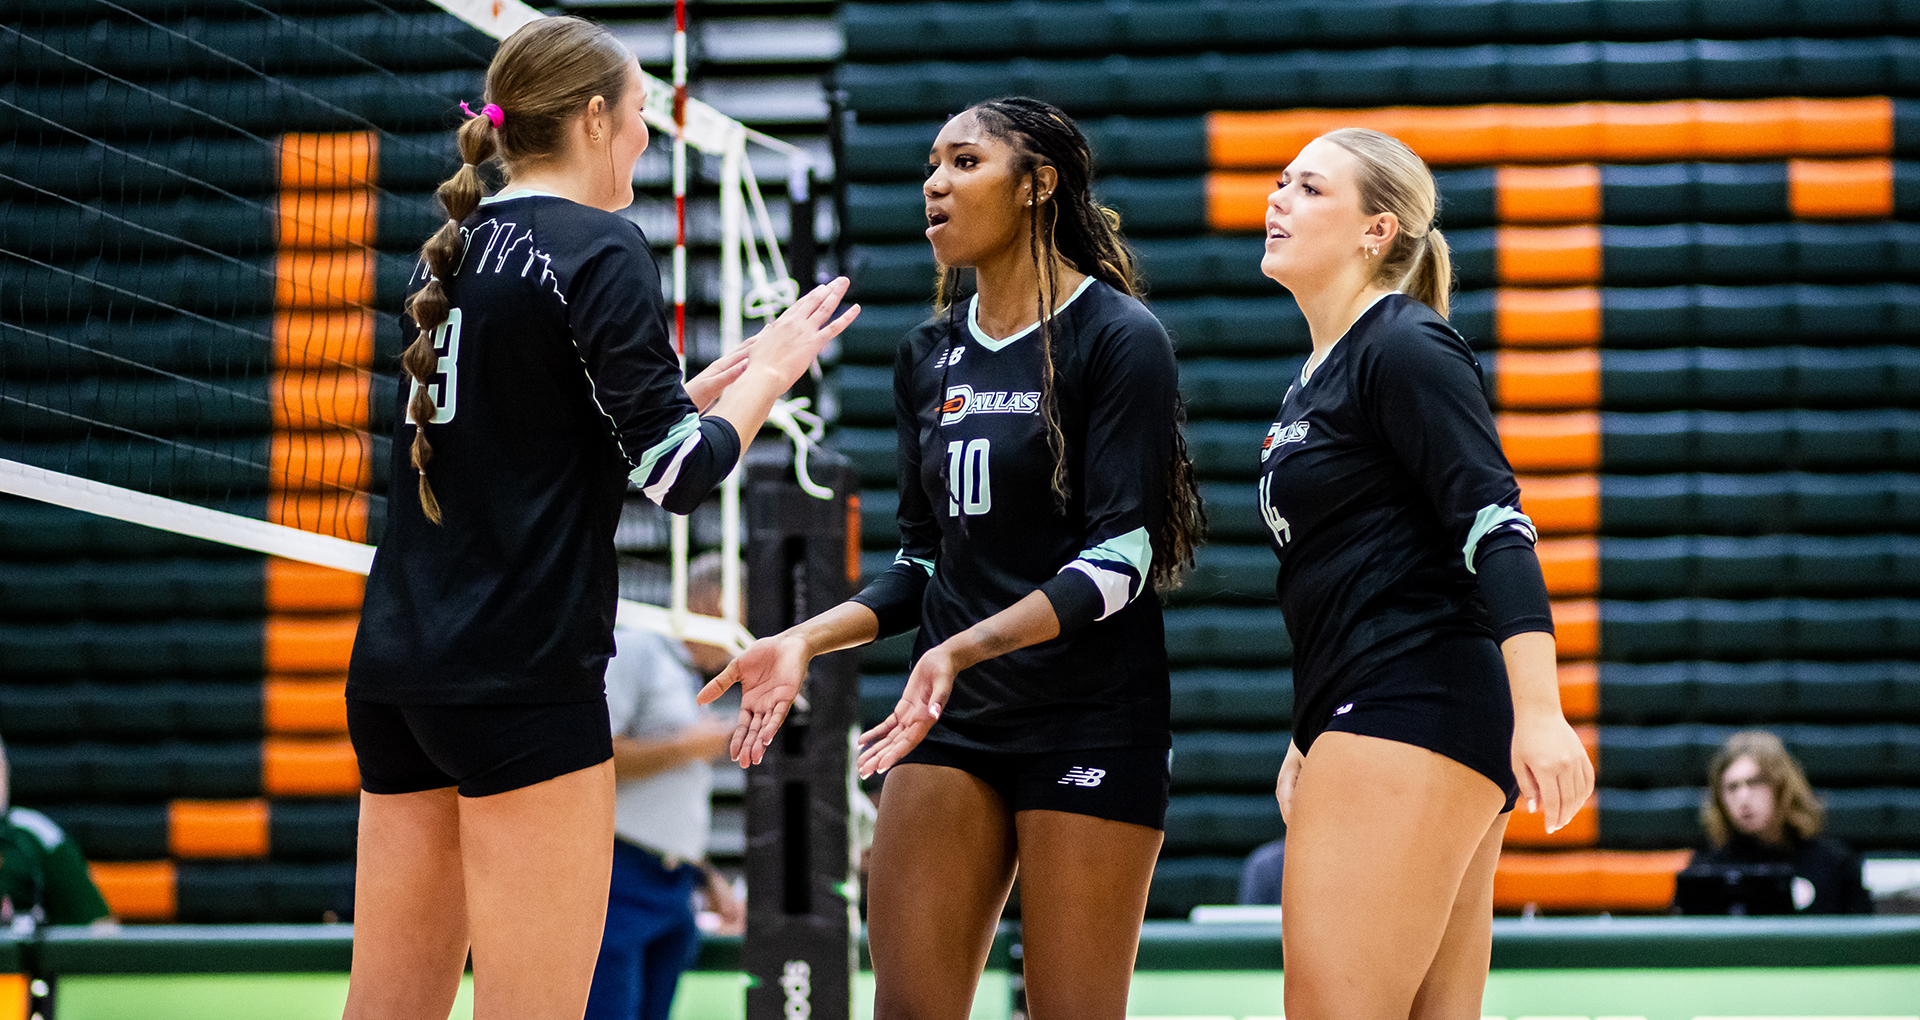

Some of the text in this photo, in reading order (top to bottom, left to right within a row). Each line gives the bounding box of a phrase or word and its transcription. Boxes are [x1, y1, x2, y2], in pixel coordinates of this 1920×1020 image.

[405, 307, 462, 425] 3
[947, 438, 991, 517] 10
[1259, 470, 1291, 547] 14
